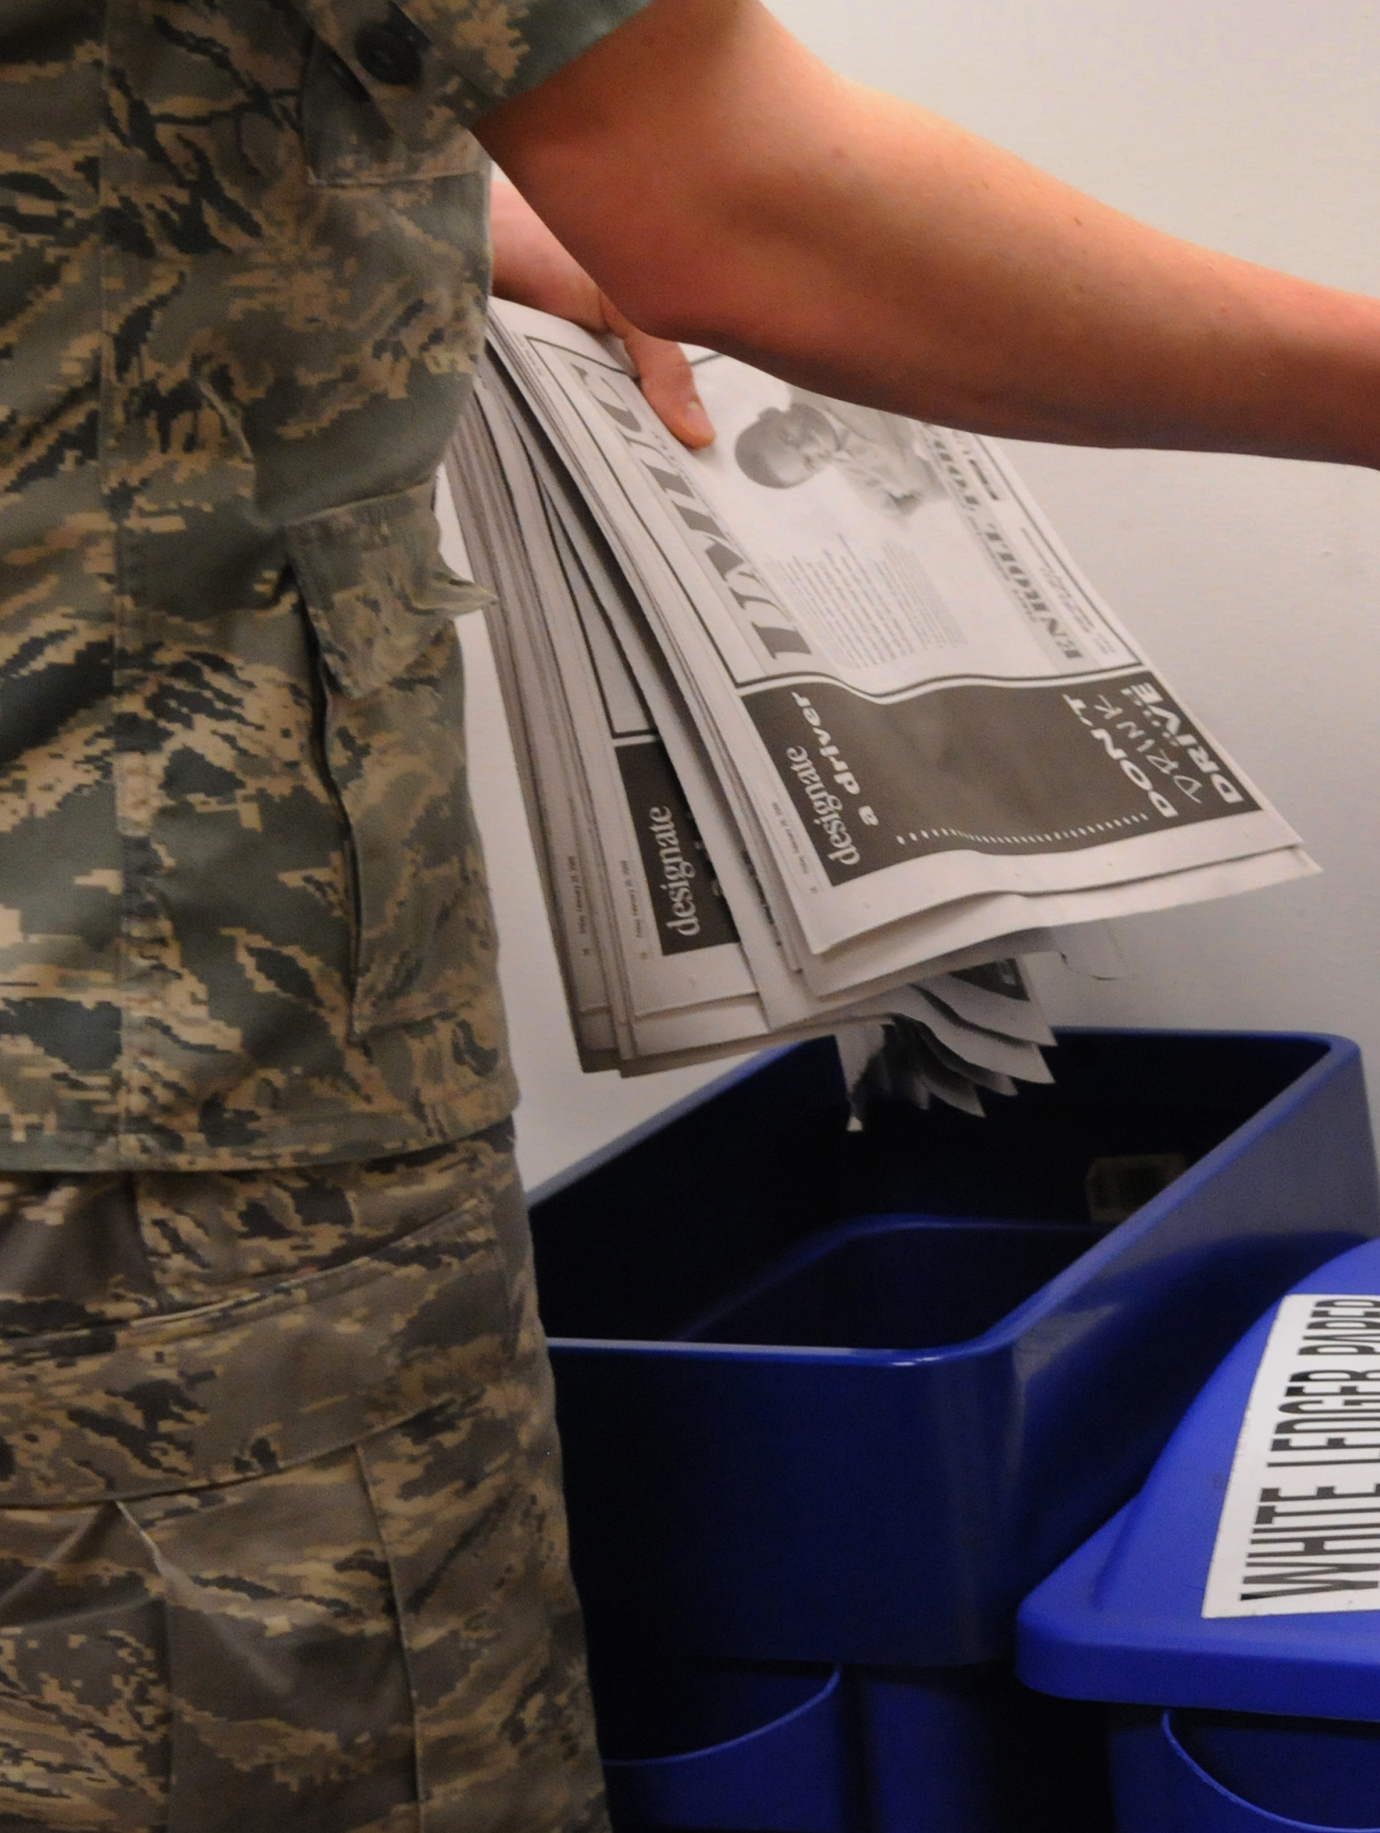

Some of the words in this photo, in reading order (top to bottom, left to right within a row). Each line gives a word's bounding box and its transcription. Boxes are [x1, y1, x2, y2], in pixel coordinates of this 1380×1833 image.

[570, 363, 812, 659] UMUC
[921, 421, 980, 511] TODA
[984, 523, 1083, 659] ENROLL
[791, 691, 860, 794] driver
[1063, 694, 1179, 818] DON'T
[1094, 695, 1203, 804] DRINK
[1130, 682, 1244, 804] DRIVE
[786, 746, 860, 865] designate
[858, 806, 879, 826] a
[648, 806, 700, 936] designate
